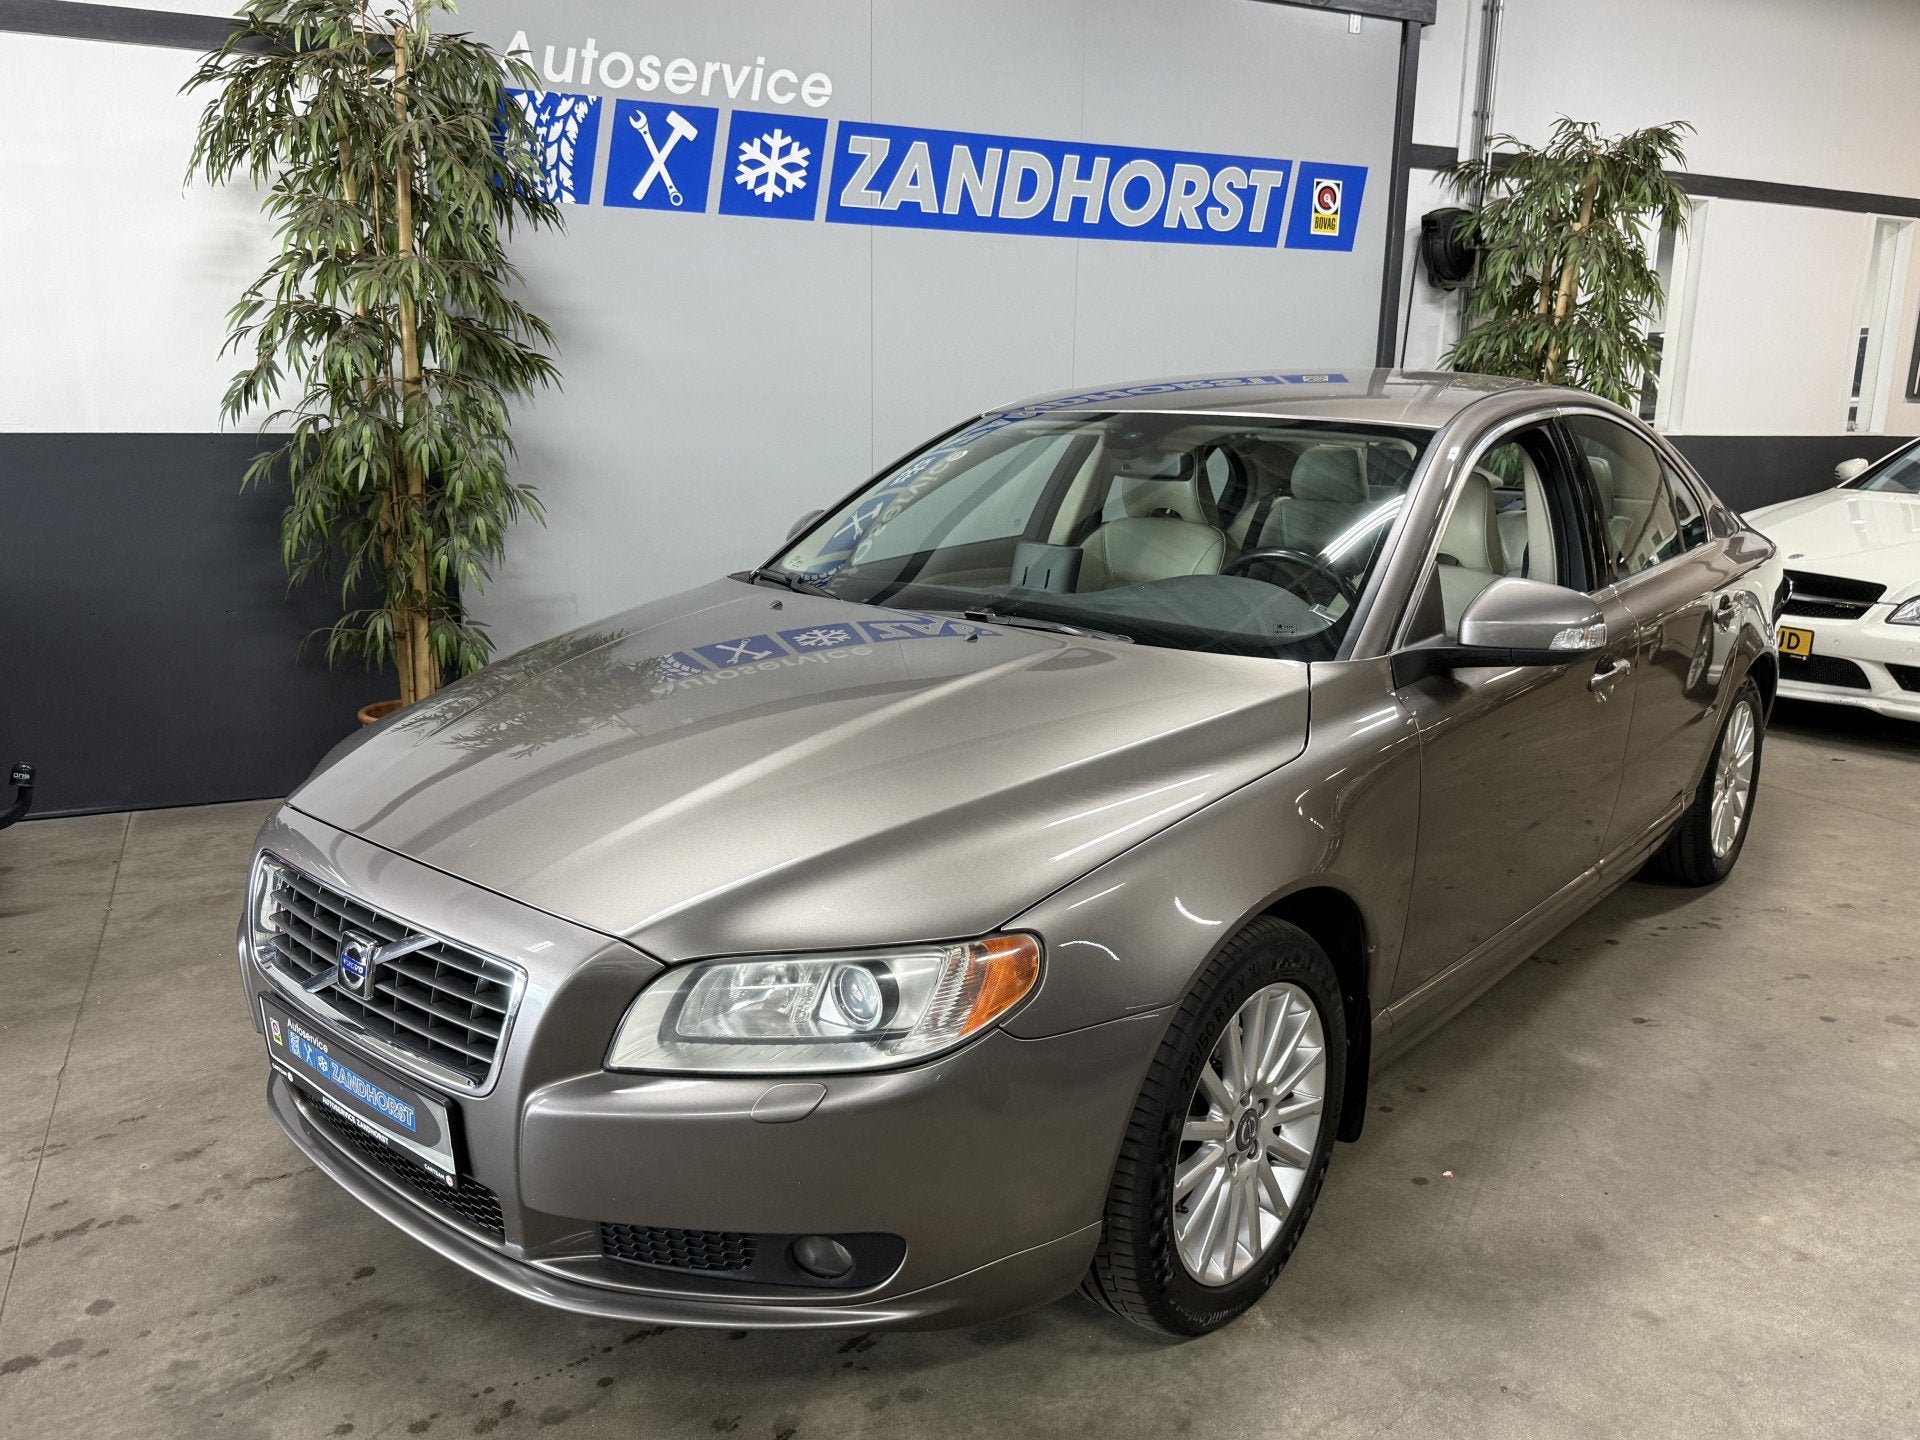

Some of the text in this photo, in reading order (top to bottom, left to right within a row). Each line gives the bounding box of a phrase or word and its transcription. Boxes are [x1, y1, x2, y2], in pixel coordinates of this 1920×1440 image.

[499, 30, 833, 108] Autoservice
[839, 135, 1283, 233] ZANDHORST
[1314, 216, 1336, 231] BOVAG
[343, 957, 364, 974] VOLVO
[287, 1018, 329, 1053] Autoservice
[1180, 1023, 1216, 1092] 225/50
[322, 1096, 389, 1145] AUTOSERVICE ZANDHORST
[331, 1062, 413, 1126] ZANDHORST
